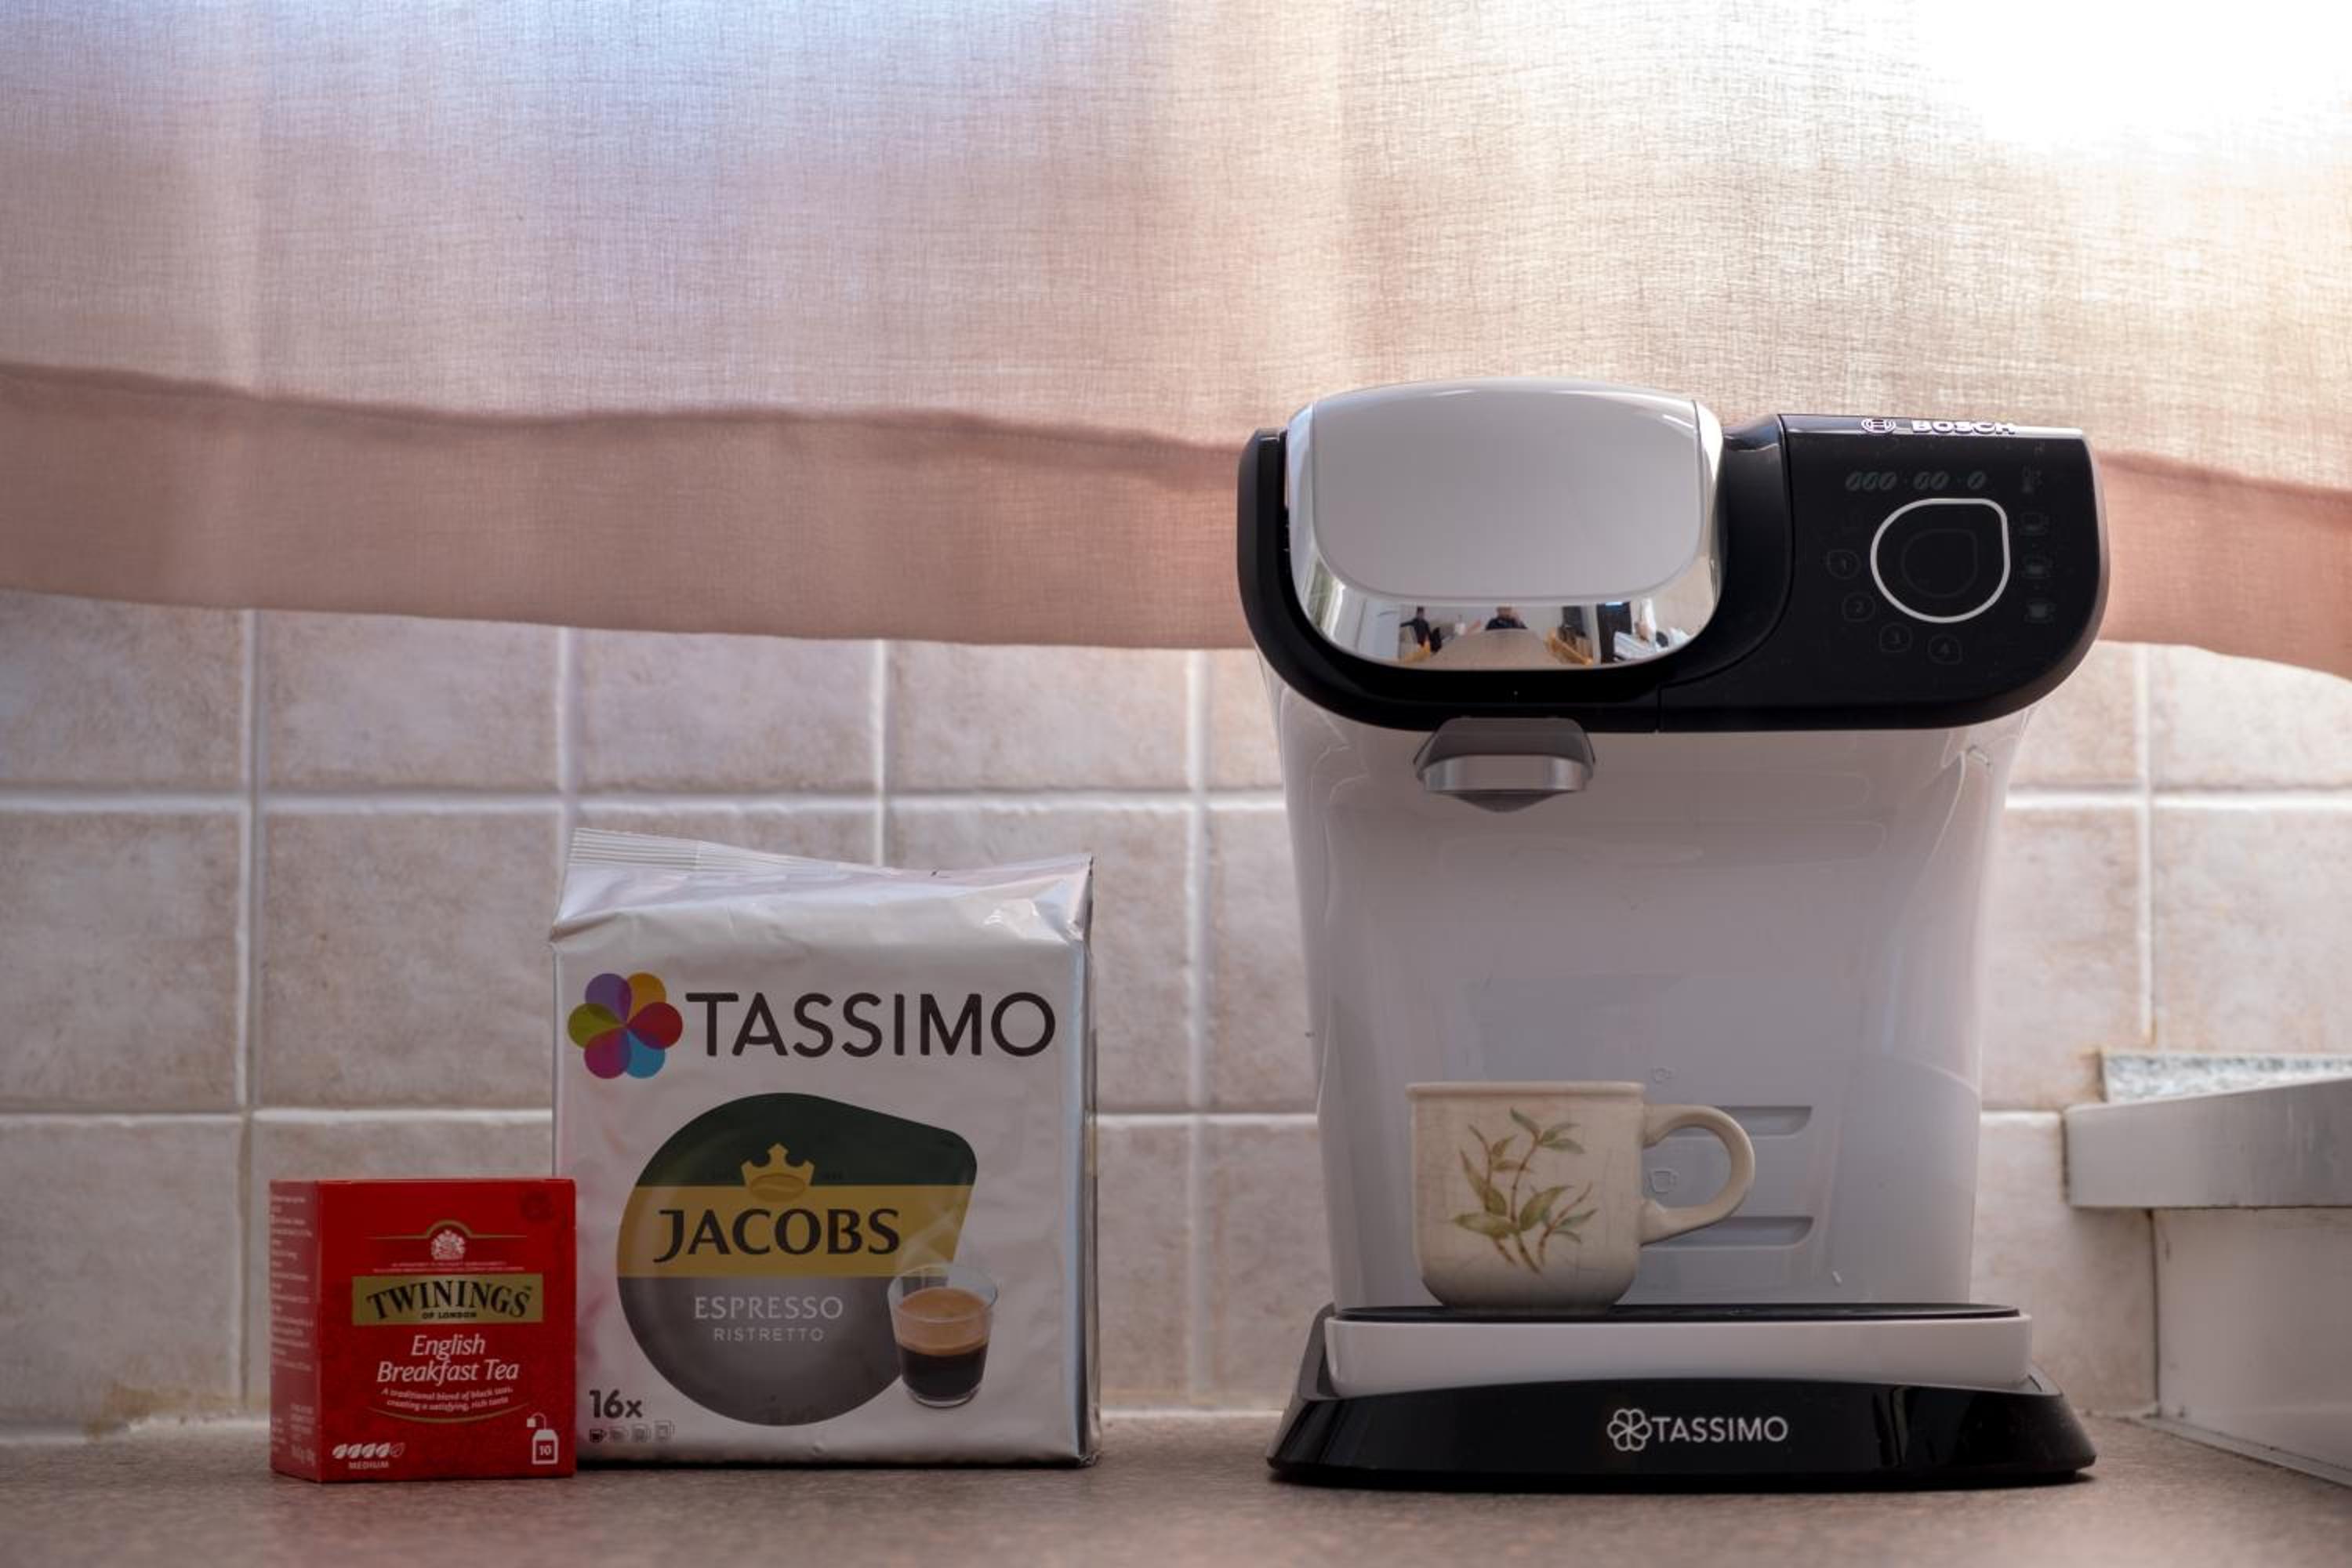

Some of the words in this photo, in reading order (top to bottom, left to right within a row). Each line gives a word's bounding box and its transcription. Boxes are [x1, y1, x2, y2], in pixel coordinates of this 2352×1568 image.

[1911, 419, 2016, 435] BOSCH
[685, 991, 1056, 1058] TASSIMO
[653, 1207, 900, 1263] JACOBS
[366, 1279, 531, 1319] TWININGS
[695, 1294, 843, 1320] ESPRESSO
[411, 1334, 485, 1361] English
[713, 1327, 824, 1341] RISTRETTO
[376, 1361, 478, 1386] Breakfast
[485, 1359, 519, 1381] Tea
[590, 1388, 642, 1419] 16x
[1652, 1416, 1788, 1443] TASSIMO
[539, 1445, 552, 1456] 10
[348, 1460, 390, 1470] MEDIUM
